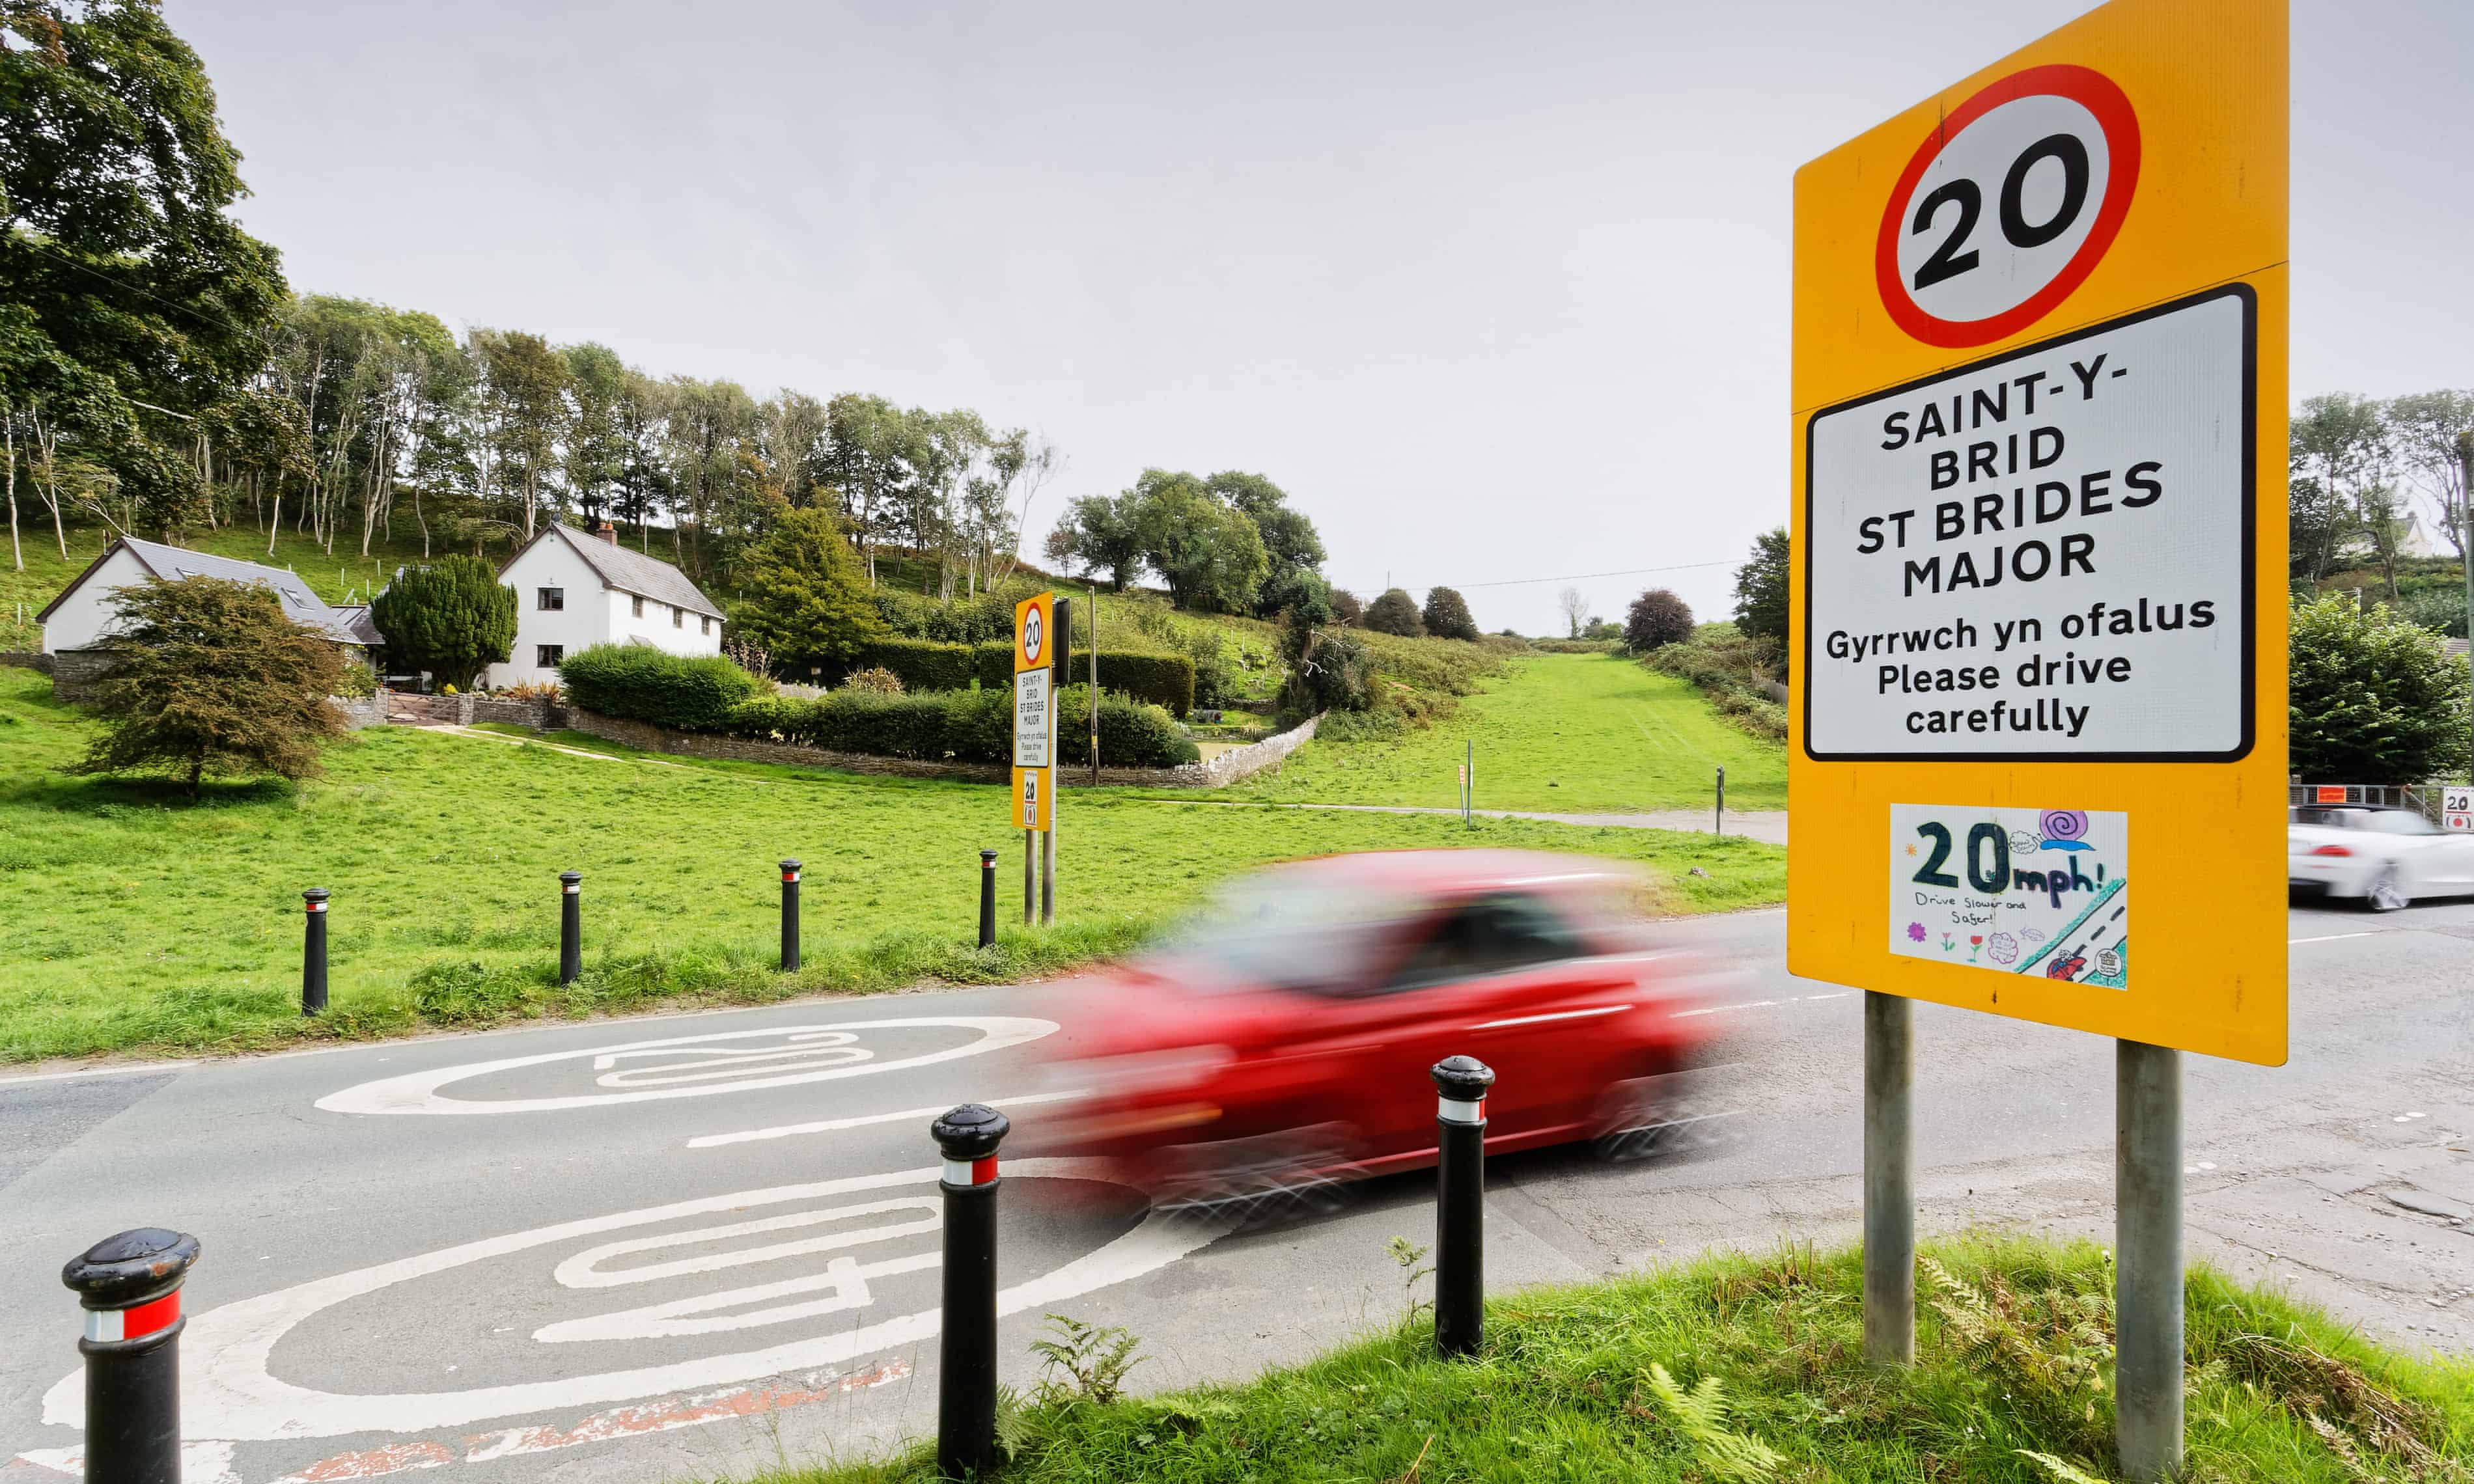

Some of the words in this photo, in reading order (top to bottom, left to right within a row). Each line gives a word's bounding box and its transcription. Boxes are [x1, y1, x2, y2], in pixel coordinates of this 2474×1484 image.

[1912, 133, 2089, 291] 20
[1881, 353, 2128, 450] SAINT-Y-
[1930, 426, 2064, 491] BRID
[1857, 510, 1915, 555] ST
[1936, 461, 2162, 542] BRIDES
[1904, 532, 2096, 598] MAJOR
[1026, 620, 1040, 647] 20
[1826, 618, 1977, 663] Gyrrwch
[1994, 616, 2042, 651] yn
[2061, 598, 2215, 639] ofalus
[1878, 663, 2000, 694] Please
[2017, 652, 2131, 687] drive
[1021, 703, 1025, 713] ST
[1027, 700, 1044, 712] BRIDES
[1027, 689, 1037, 699] BRID
[1024, 715, 1039, 725] MAJOR
[1906, 698, 2089, 737] carefully
[1025, 780, 1035, 800] 20
[2448, 796, 2467, 810] 20
[1915, 892, 1955, 905] Drive
[1964, 897, 2002, 908] Slower
[1951, 911, 1993, 926] Safer!
